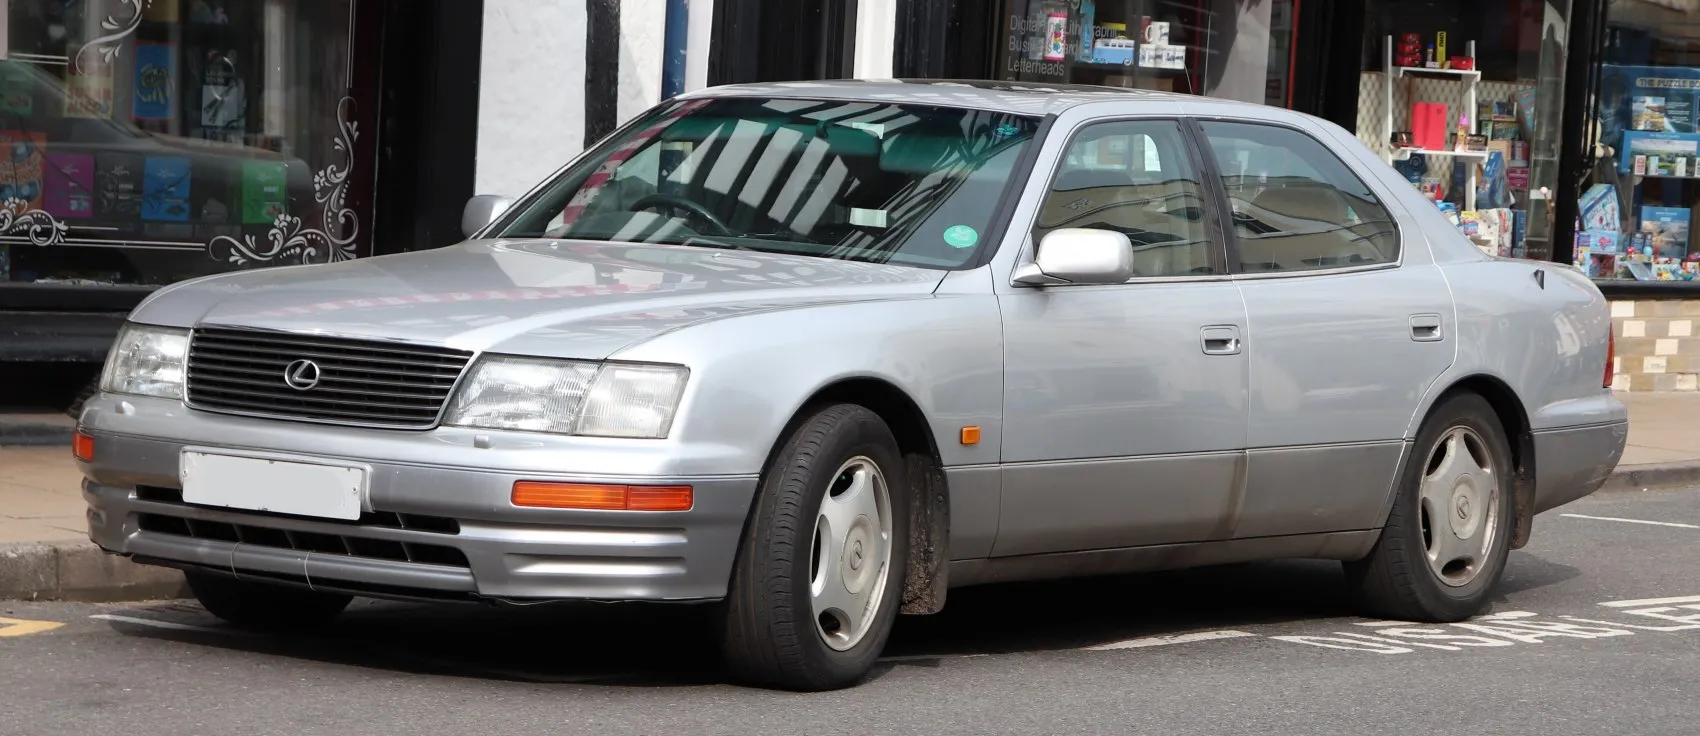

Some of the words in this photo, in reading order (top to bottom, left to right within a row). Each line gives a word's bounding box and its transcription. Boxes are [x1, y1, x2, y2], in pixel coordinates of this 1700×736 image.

[1007, 56, 1064, 76] Letterheads
[1640, 79, 1658, 88] THE
[1658, 80, 1687, 88] PUZZLE
[1268, 604, 1700, 655] DISABLE
